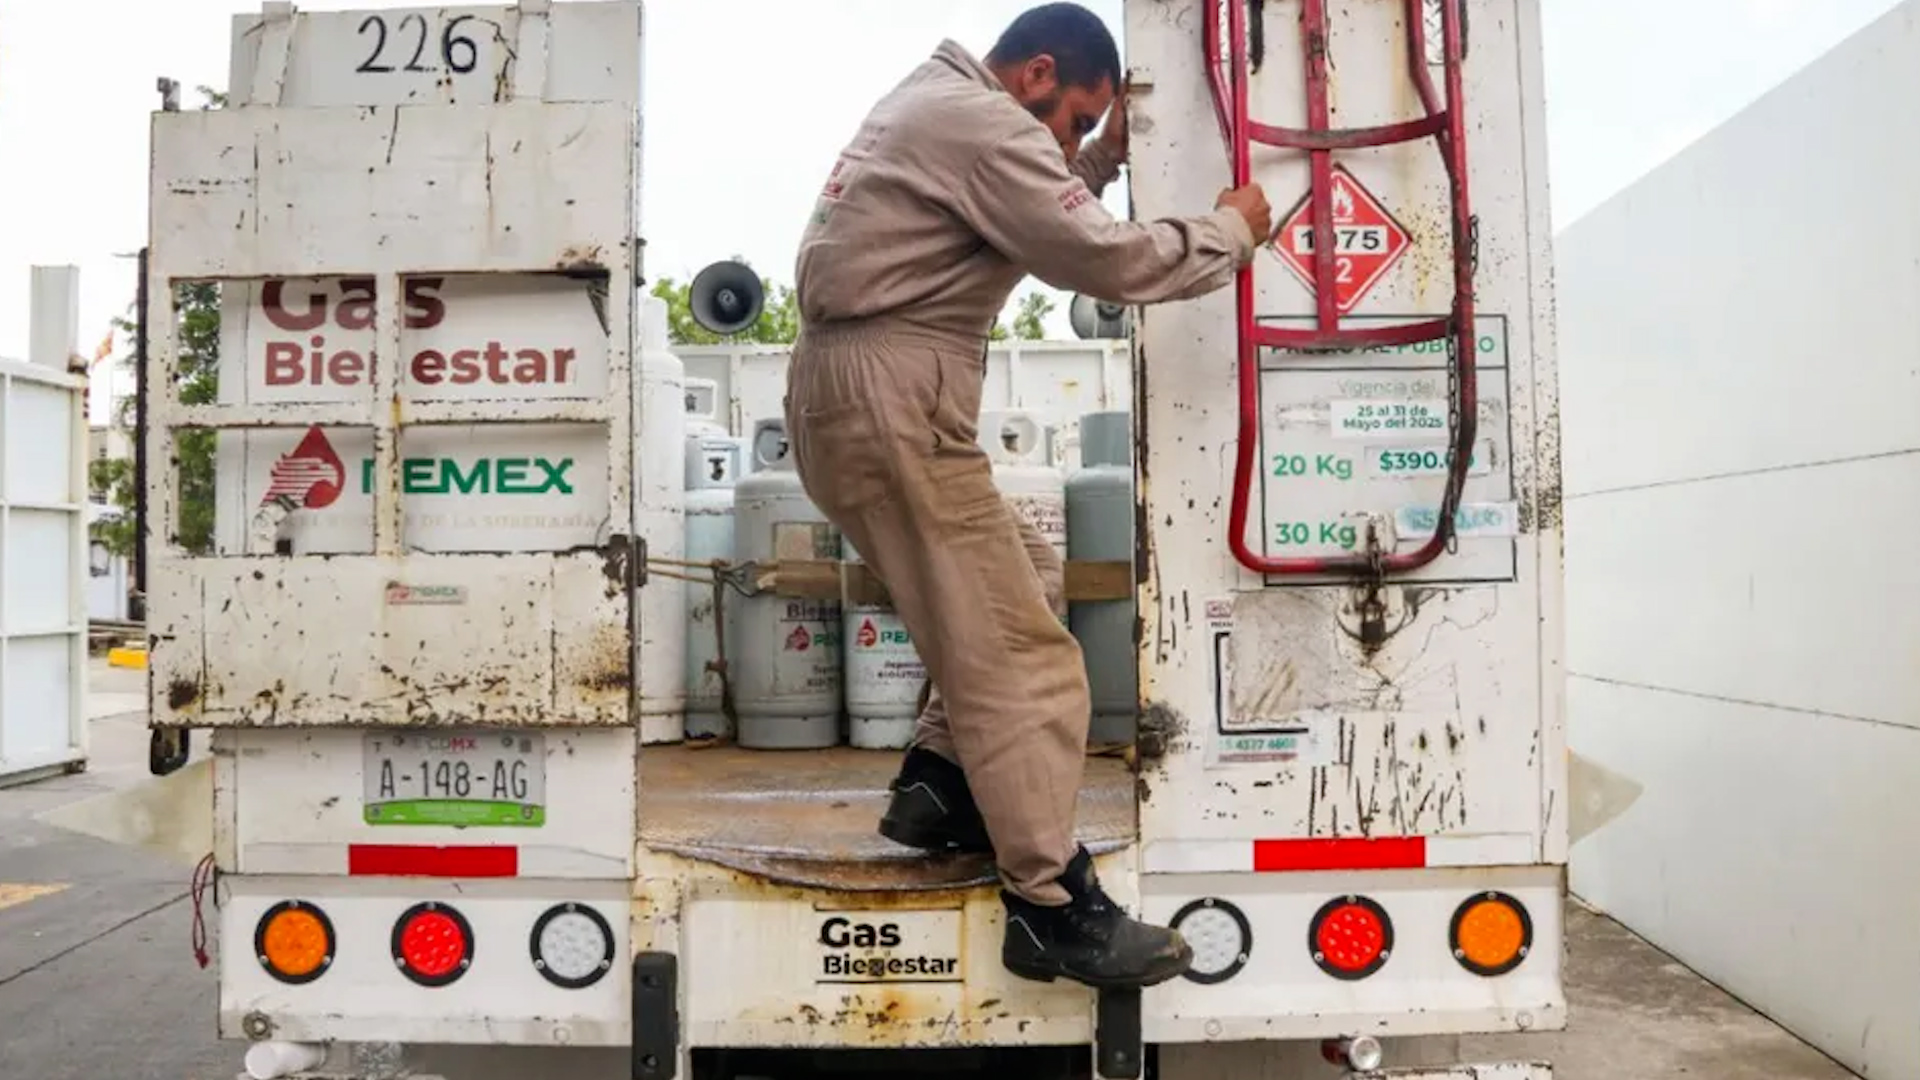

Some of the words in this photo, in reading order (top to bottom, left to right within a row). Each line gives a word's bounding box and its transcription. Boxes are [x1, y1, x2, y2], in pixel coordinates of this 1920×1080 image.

[355, 15, 477, 74] 226
[1301, 229, 1380, 250] 175
[1335, 257, 1353, 283] 2
[1339, 380, 1407, 398] Vigencia
[1357, 405, 1373, 417] 25
[1377, 404, 1390, 417] al
[1393, 405, 1407, 417] 31
[1410, 405, 1428, 417] de
[1343, 419, 1381, 432] Mayo
[1384, 418, 1406, 429] del
[1409, 418, 1444, 428] 2025
[1272, 455, 1307, 476] 20
[1316, 454, 1353, 480] Kg
[1274, 521, 1310, 545] 30
[1318, 521, 1357, 550] Kg
[379, 758, 528, 799] A-148-AG
[821, 917, 901, 948] Gas
